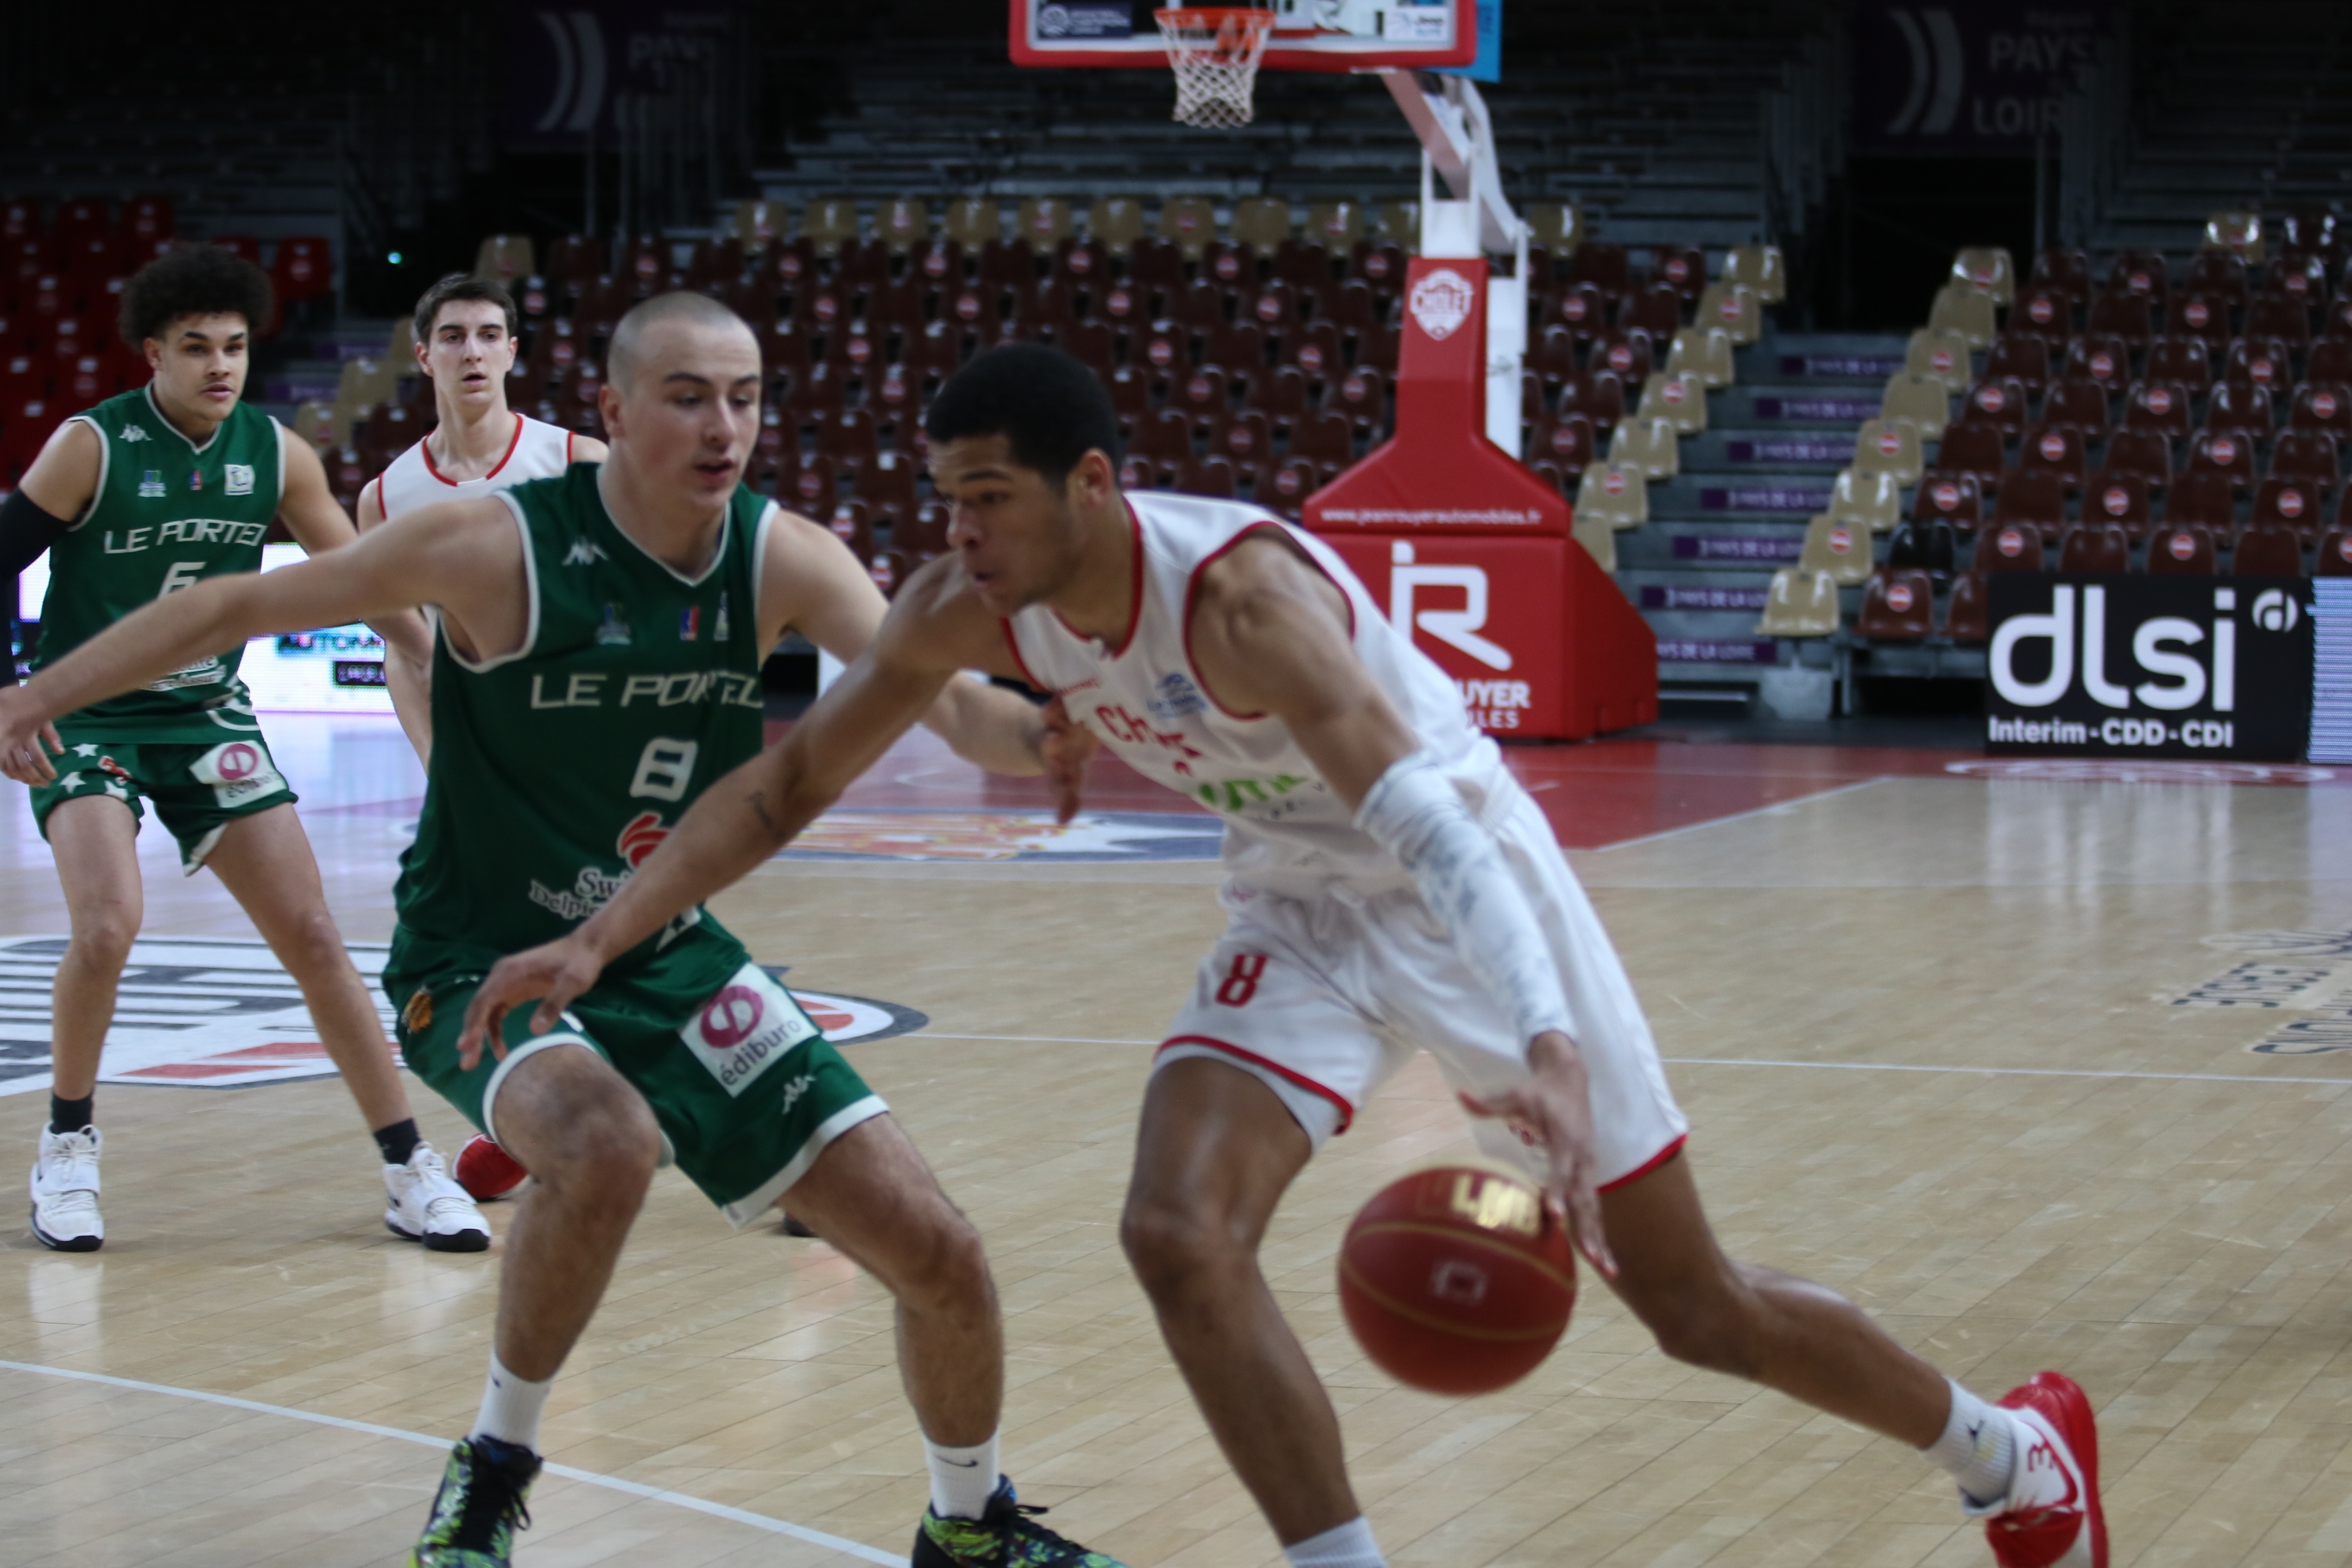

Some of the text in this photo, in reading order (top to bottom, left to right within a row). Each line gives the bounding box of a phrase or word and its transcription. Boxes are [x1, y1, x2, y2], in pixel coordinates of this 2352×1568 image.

[104, 526, 153, 555] LE
[1989, 583, 2236, 711] dlsi
[530, 673, 609, 710] LE
[1455, 679, 1532, 710] UYER
[629, 737, 699, 803] 8
[1215, 953, 1269, 1008] 8
